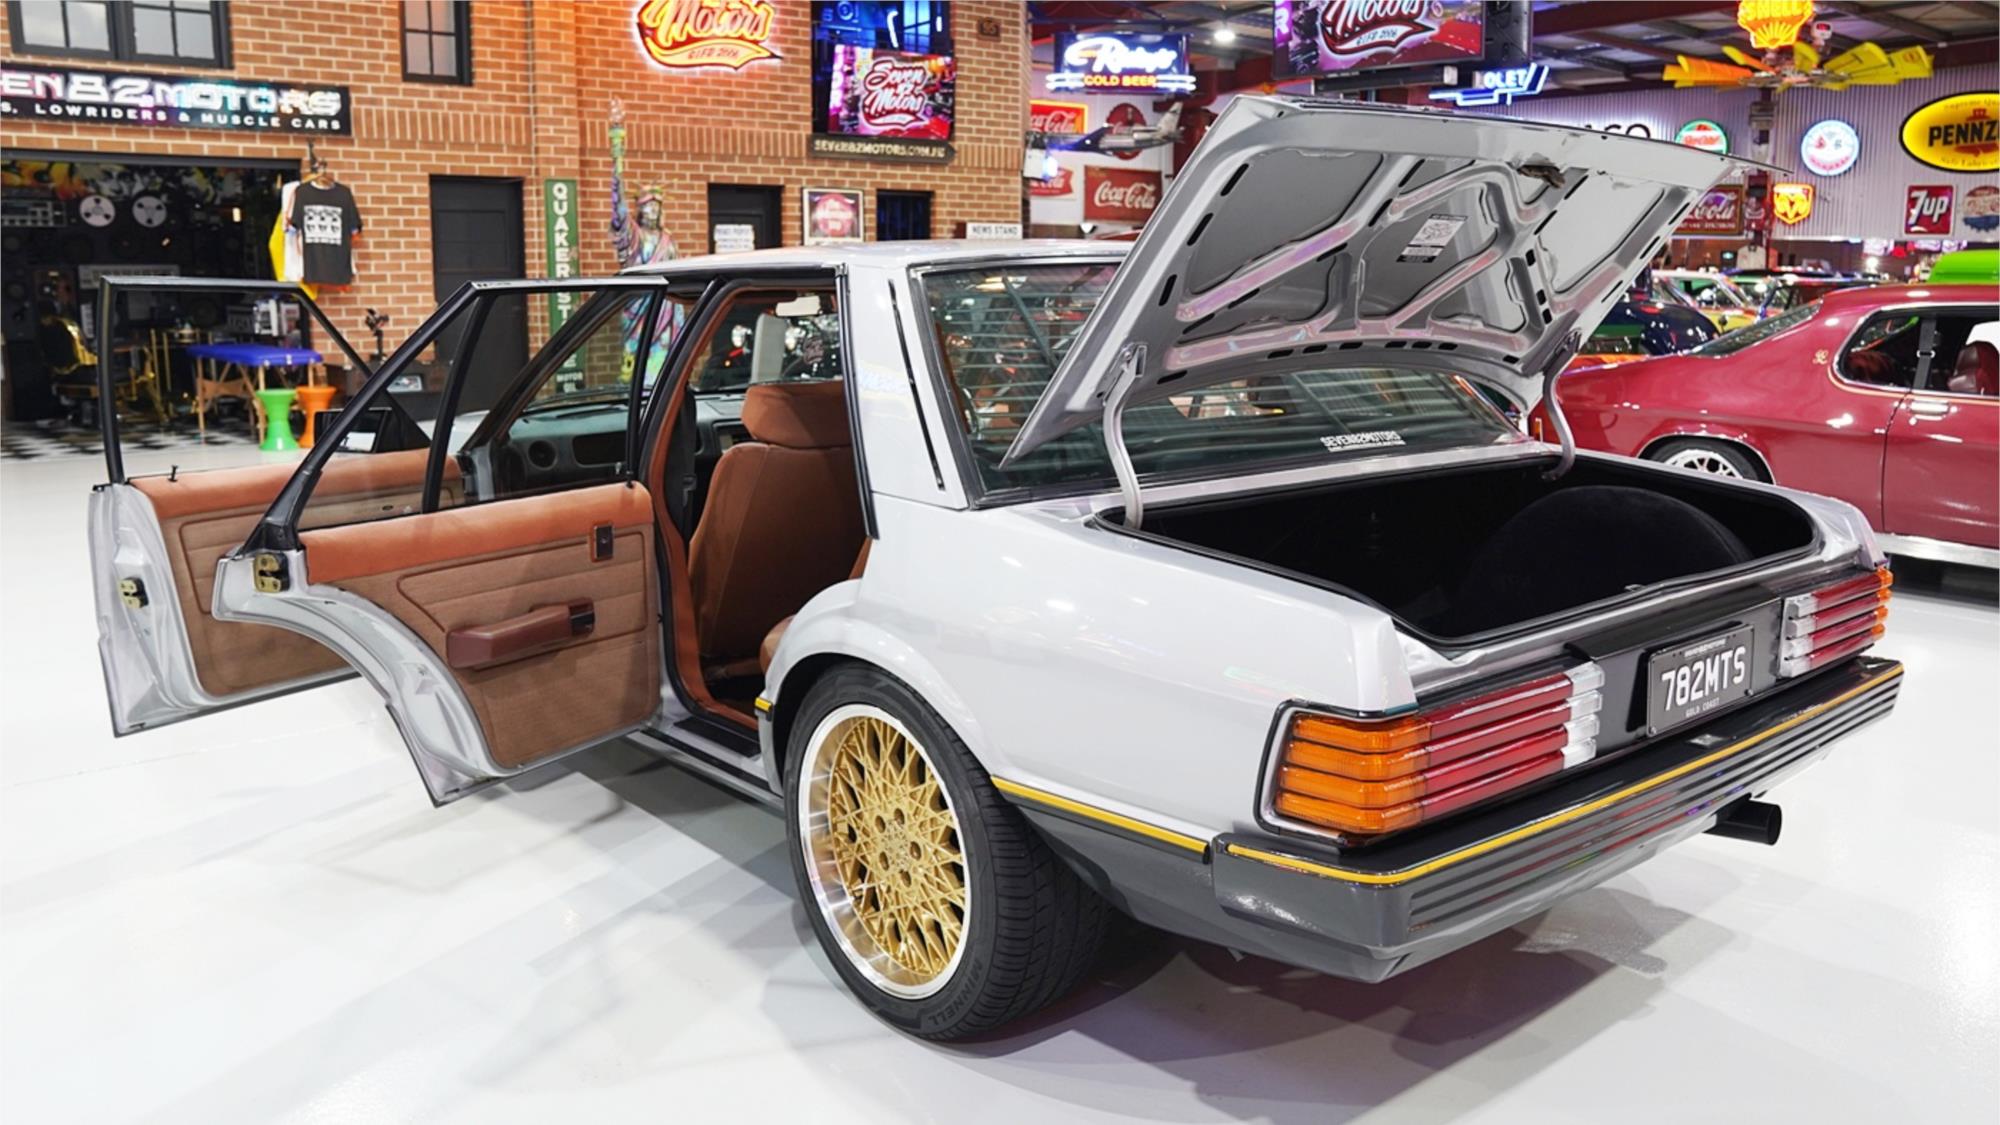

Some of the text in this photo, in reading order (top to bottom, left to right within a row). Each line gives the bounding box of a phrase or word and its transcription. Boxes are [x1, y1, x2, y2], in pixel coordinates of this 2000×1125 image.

[1084, 75, 1157, 87] COLD BEER
[35, 104, 167, 121] LOWRIDERS
[178, 112, 191, 122] &
[201, 113, 281, 127] MUSCLE
[291, 119, 341, 130] CARS
[1928, 119, 2000, 147] PENNZ
[552, 183, 569, 278] QUAKER
[557, 291, 577, 368] STE
[1662, 646, 1746, 711] 782MTS
[1685, 705, 1700, 718] GOLD
